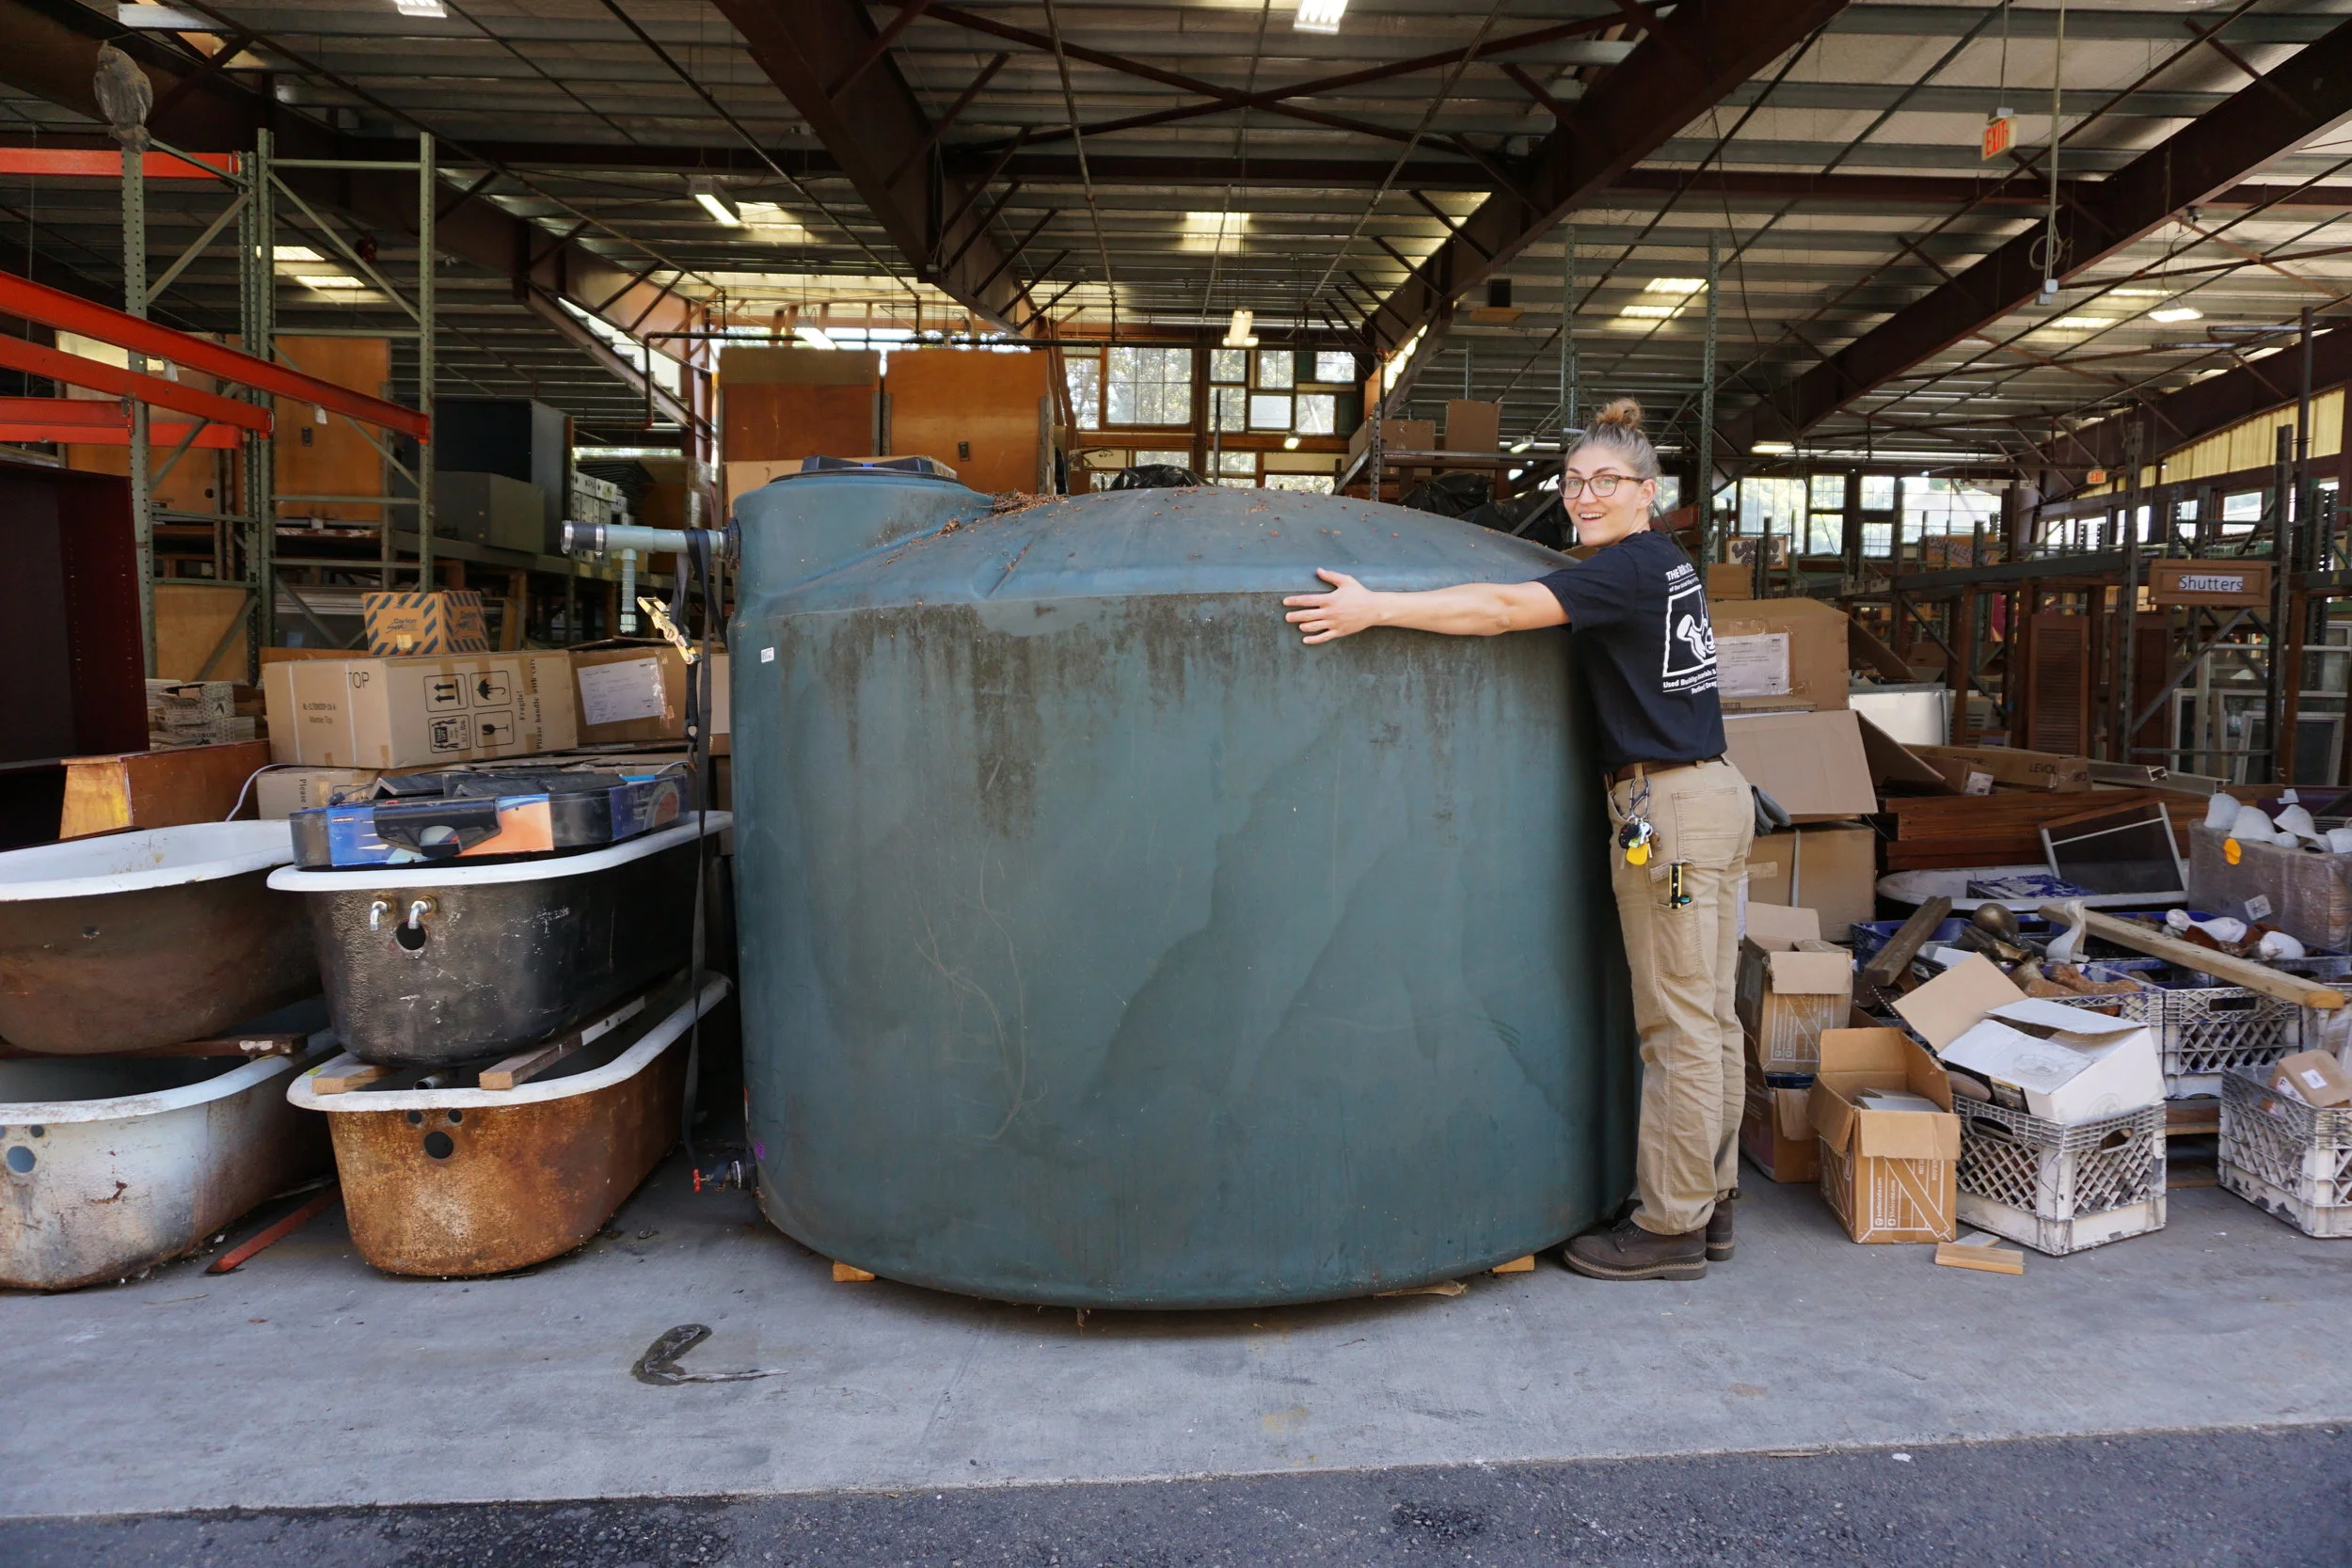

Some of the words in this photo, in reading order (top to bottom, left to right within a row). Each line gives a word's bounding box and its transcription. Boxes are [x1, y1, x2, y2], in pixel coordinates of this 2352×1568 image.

[1986, 119, 2007, 155] EXIT
[1665, 568, 1680, 581] THE
[2178, 575, 2243, 591] Shutters
[1662, 679, 1679, 689] Used
[516, 690, 526, 721] Fragile!
[533, 697, 543, 723] handle
[299, 778, 308, 802] Please
